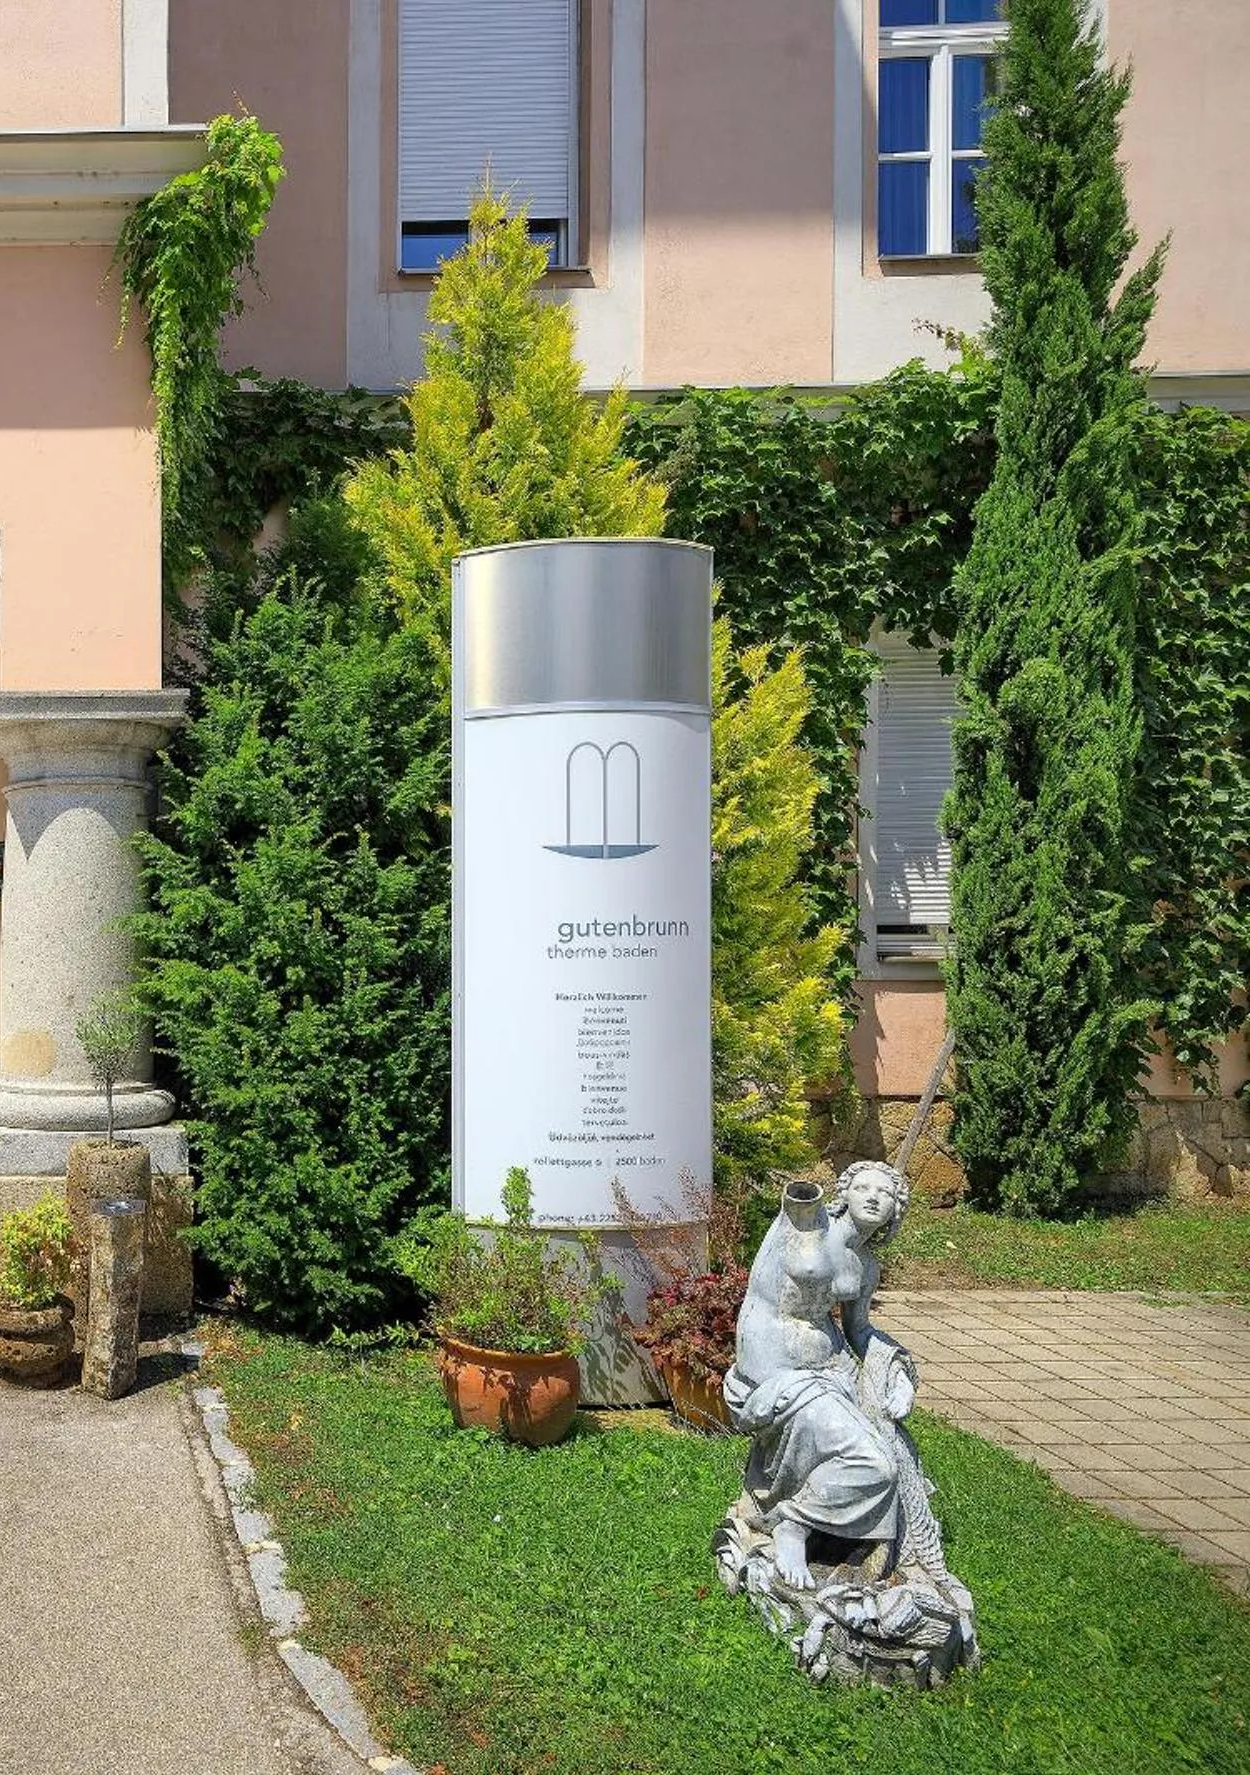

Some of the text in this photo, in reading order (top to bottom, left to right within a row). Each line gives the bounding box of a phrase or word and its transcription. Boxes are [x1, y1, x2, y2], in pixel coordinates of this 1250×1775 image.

[557, 915, 690, 943] gutenbrunn
[547, 944, 658, 959] therme baden
[616, 1156, 637, 1166] 2500
